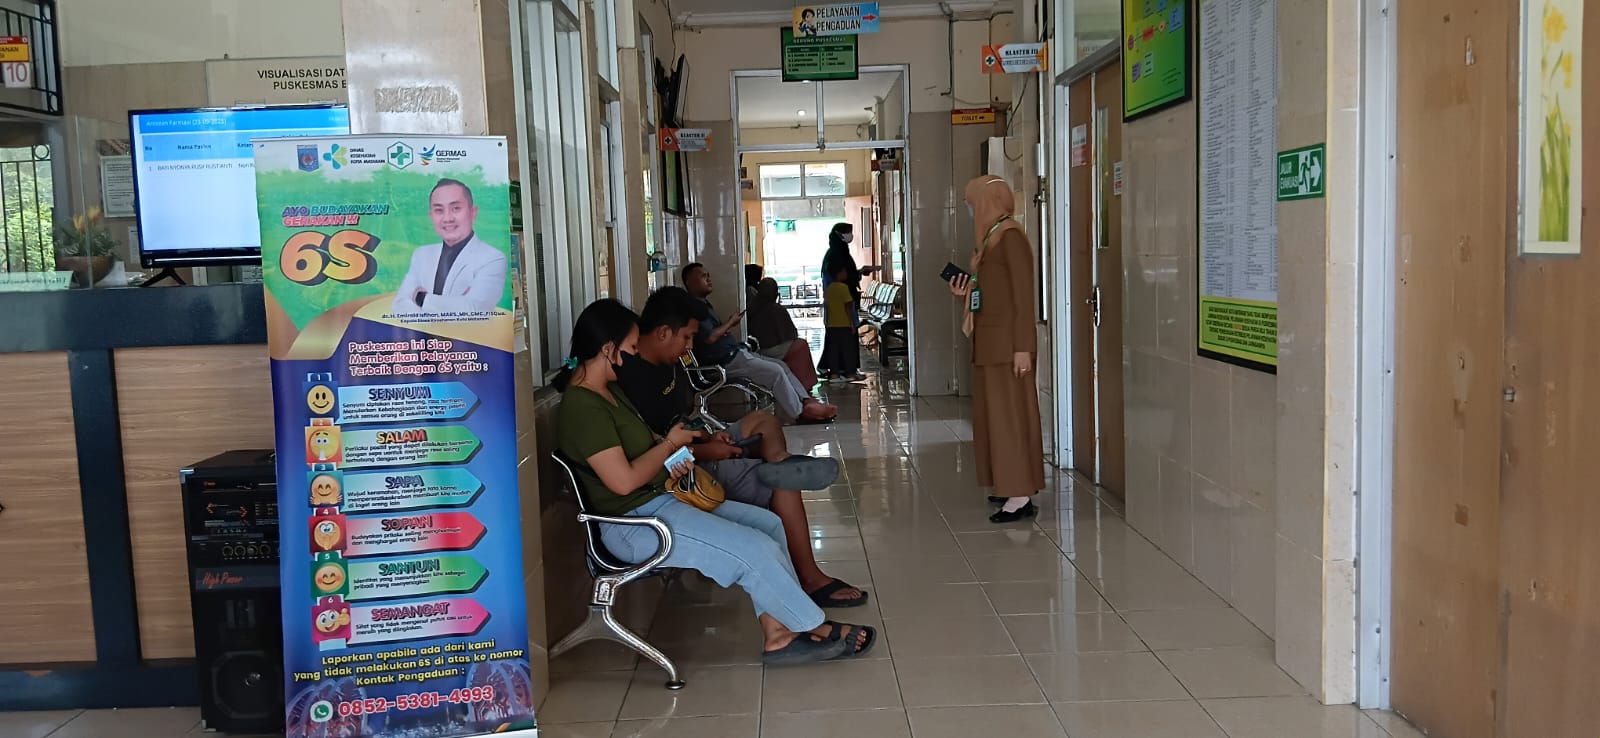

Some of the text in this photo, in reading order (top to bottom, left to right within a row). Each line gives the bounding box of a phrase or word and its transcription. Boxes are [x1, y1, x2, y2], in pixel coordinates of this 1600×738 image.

[816, 6, 860, 18] PELAYANAN
[816, 19, 860, 32] PENGADUAN
[6, 63, 28, 82] 10
[257, 69, 322, 79] VISUALISASI
[273, 80, 339, 90] PUSKESMAS
[282, 204, 390, 217] AYO BUDAYAKAN
[283, 214, 345, 227] GERAKAN
[280, 229, 381, 287] 6S
[348, 341, 409, 353] Puskesmas
[427, 339, 452, 352] Siap
[349, 350, 478, 365] Memberikan Pelayanan
[350, 365, 392, 377] Terbaik
[392, 364, 436, 376] Dengan
[438, 363, 453, 373] 6S
[453, 361, 482, 375] yaitu
[368, 385, 432, 402] SENYUM
[376, 429, 428, 445] SALAM
[384, 474, 425, 490] SAPA
[381, 515, 433, 531] SOPAN
[378, 559, 440, 576] SANTUN
[375, 582, 390, 590] yang
[379, 576, 394, 584] yang
[370, 602, 451, 621] SEMANGAT
[370, 622, 385, 630] yang
[377, 627, 392, 635] yang
[321, 639, 496, 666] Laporkan apabila ada dari kami
[293, 648, 524, 682] yang tidak melakukan 6S di atas ke nomor
[355, 674, 394, 686] Kontak
[397, 666, 459, 683] Pengaduan
[337, 684, 495, 717] 0852-5381-4993
